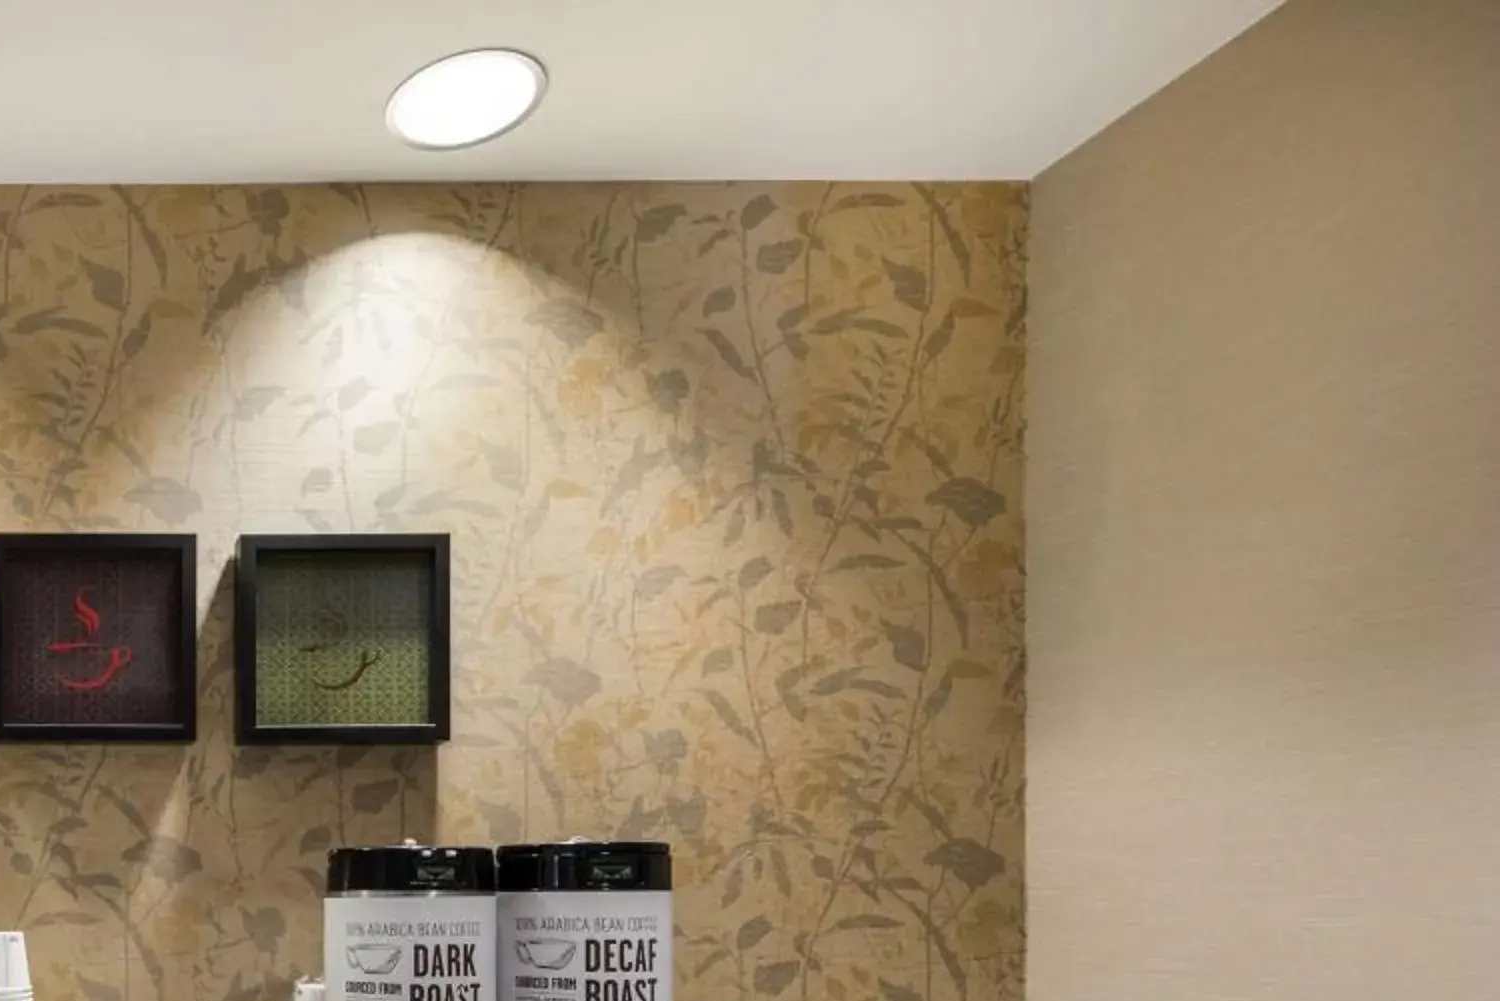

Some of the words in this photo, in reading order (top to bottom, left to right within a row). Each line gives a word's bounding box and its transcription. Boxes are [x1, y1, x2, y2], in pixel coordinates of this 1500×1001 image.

[413, 943, 477, 977] DARK
[585, 938, 658, 972] DECAF
[551, 977, 577, 990] FROM
